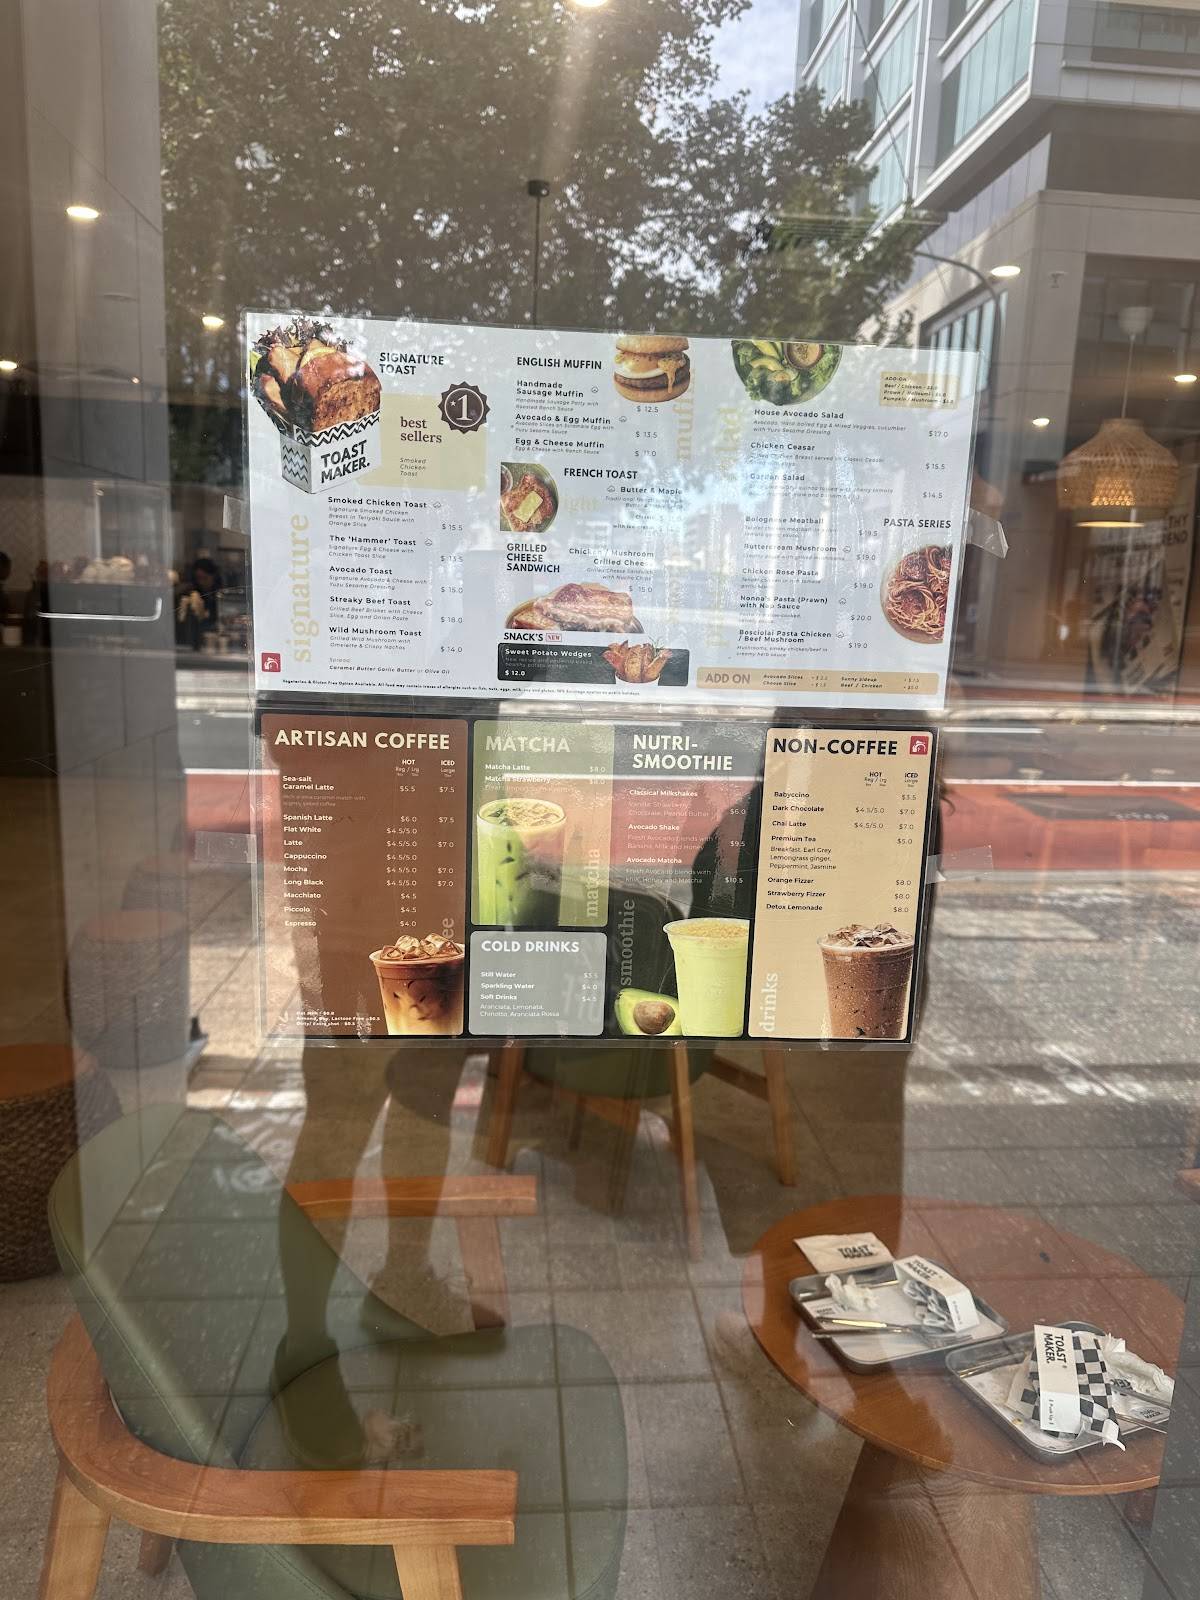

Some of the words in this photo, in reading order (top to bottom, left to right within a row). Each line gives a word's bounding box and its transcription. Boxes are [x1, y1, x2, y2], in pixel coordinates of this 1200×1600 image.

[379, 352, 444, 365] SIGNATURE
[517, 357, 560, 368] ENGLISH
[564, 360, 602, 370] MUFFIN
[380, 365, 416, 375] TOAST
[517, 380, 563, 388] Handmade
[516, 389, 551, 397] Sausage
[555, 390, 584, 398] Muffin
[456, 394, 472, 421] 1
[754, 409, 780, 417] House
[783, 410, 818, 418] Avocado
[821, 411, 844, 419] Salad
[400, 417, 427, 429] best
[563, 416, 579, 424] Egg
[583, 416, 611, 425] Muffin
[400, 431, 442, 444] sellers
[515, 438, 531, 446] Egg
[543, 439, 573, 447] Cheese
[321, 440, 368, 468] TOAST
[321, 461, 370, 483] MAKER.
[564, 468, 603, 477] FRENCH
[606, 470, 638, 479] TOAST
[328, 497, 363, 505] Smoked
[883, 518, 915, 527] PASTA
[918, 519, 952, 529] SERIES
[507, 543, 547, 553] GRILLED
[507, 553, 543, 563] CHEESE
[329, 566, 366, 574] Avocado
[369, 567, 392, 575] Toast
[506, 563, 560, 573] SANDWICH
[286, 514, 319, 662] signature
[330, 596, 363, 605] Streaky
[504, 632, 543, 642] SNACK'S
[532, 649, 558, 657] Potato
[560, 650, 592, 658] Wedges
[705, 673, 729, 684] ADD
[732, 674, 750, 684] ON
[274, 729, 367, 748] ARTISAN
[374, 732, 450, 750] COFFEE
[486, 735, 570, 753] MATCHA
[633, 734, 697, 750] NUTRI-
[773, 738, 898, 755] NON-COFFEE
[632, 753, 733, 771] SMOOTHIE
[629, 789, 658, 797] Classical
[660, 789, 698, 798] Milkshakes
[283, 814, 312, 822] Spanish
[628, 823, 657, 831] Avocado
[659, 823, 680, 831] Shake
[284, 853, 327, 861] Cappuccino
[657, 857, 682, 865] Matcha
[586, 848, 601, 918] matcha
[481, 940, 521, 952] COLD
[525, 941, 580, 953] DRINKS
[618, 899, 635, 985] smoothie
[480, 982, 512, 991] Sparkling
[759, 972, 778, 1032] drinks
[1044, 1333, 1056, 1364] MAKER.
[1054, 1336, 1067, 1363] TOAST
